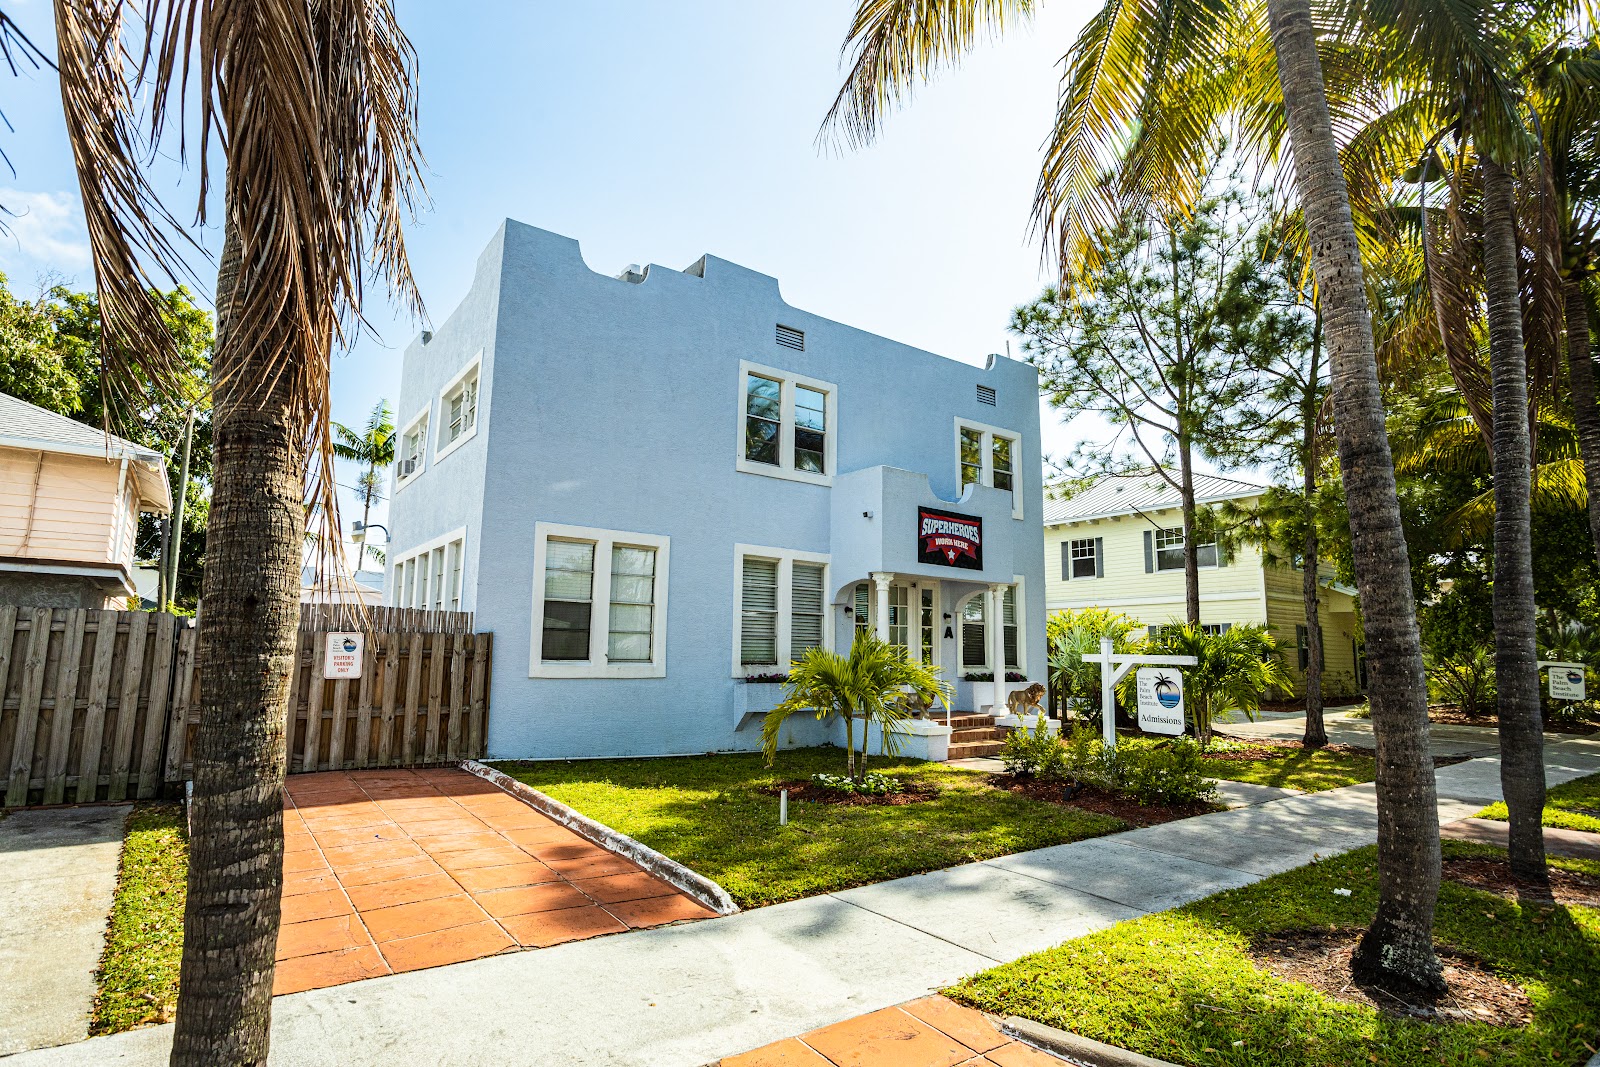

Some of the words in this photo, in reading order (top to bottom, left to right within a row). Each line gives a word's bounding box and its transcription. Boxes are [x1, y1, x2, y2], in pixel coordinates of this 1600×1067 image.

[921, 518, 980, 544] SUPERHEROES
[935, 537, 953, 546] WORK
[953, 538, 969, 550] HERE
[943, 626, 954, 639] A
[1552, 690, 1580, 698] Institute
[1139, 699, 1159, 707] Institute
[1141, 714, 1182, 726] Admissions
